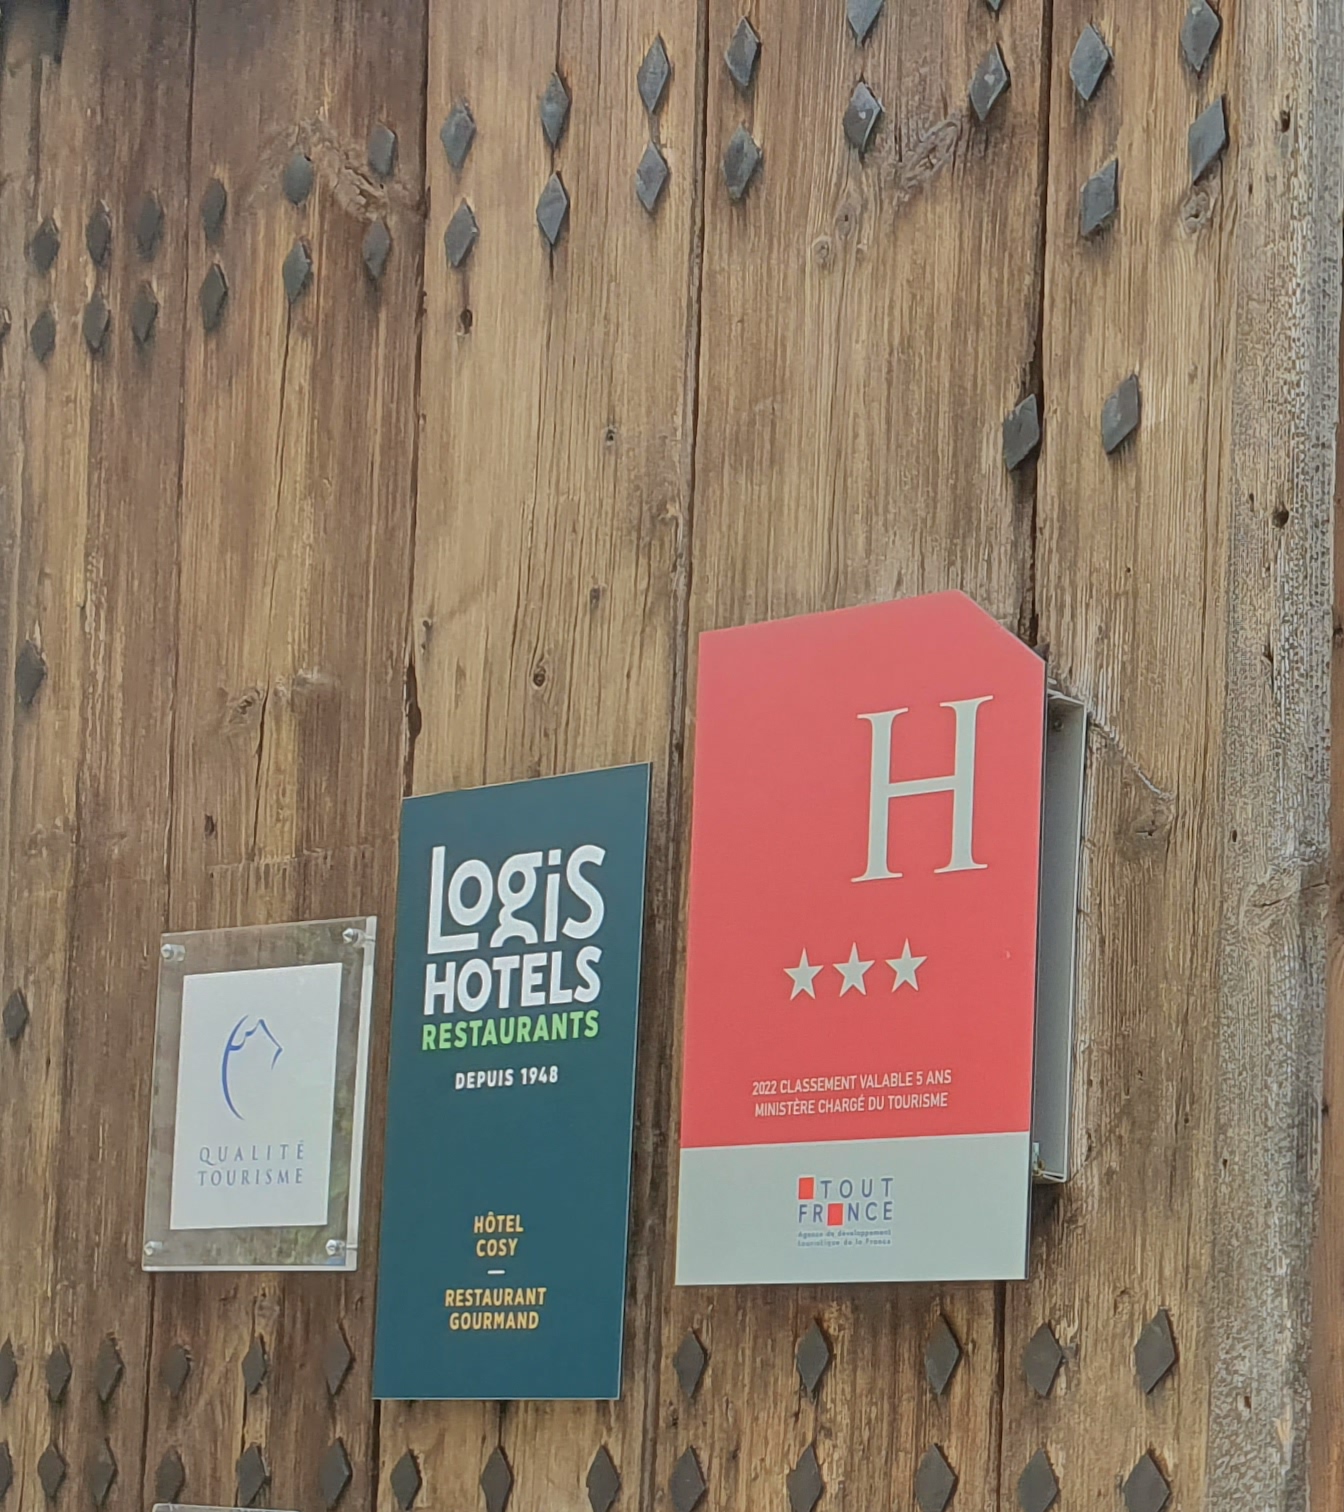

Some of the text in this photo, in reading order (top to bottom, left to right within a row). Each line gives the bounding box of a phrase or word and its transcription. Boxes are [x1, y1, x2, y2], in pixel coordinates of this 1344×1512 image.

[851, 695, 993, 882] H
[424, 946, 602, 1015] HOTELS
[422, 1010, 599, 1050] RESTAURANTS
[455, 1065, 558, 1090] DEPUIS 1948
[752, 1069, 952, 1096] 2022 CLASSEMENT VALABLE 5 ANS
[755, 1092, 949, 1117] MINISTÈRE CHARGÉ DU TOURISME
[199, 1140, 304, 1166] QUALITÉ
[198, 1168, 303, 1186] TOURISME
[820, 1177, 893, 1199] TOUT
[474, 1211, 524, 1233] HÔTEL
[798, 1201, 893, 1224] FRNCE
[476, 1238, 518, 1257] COSY
[445, 1287, 547, 1307] RESTAURANT
[450, 1311, 540, 1330] GOURMAND
